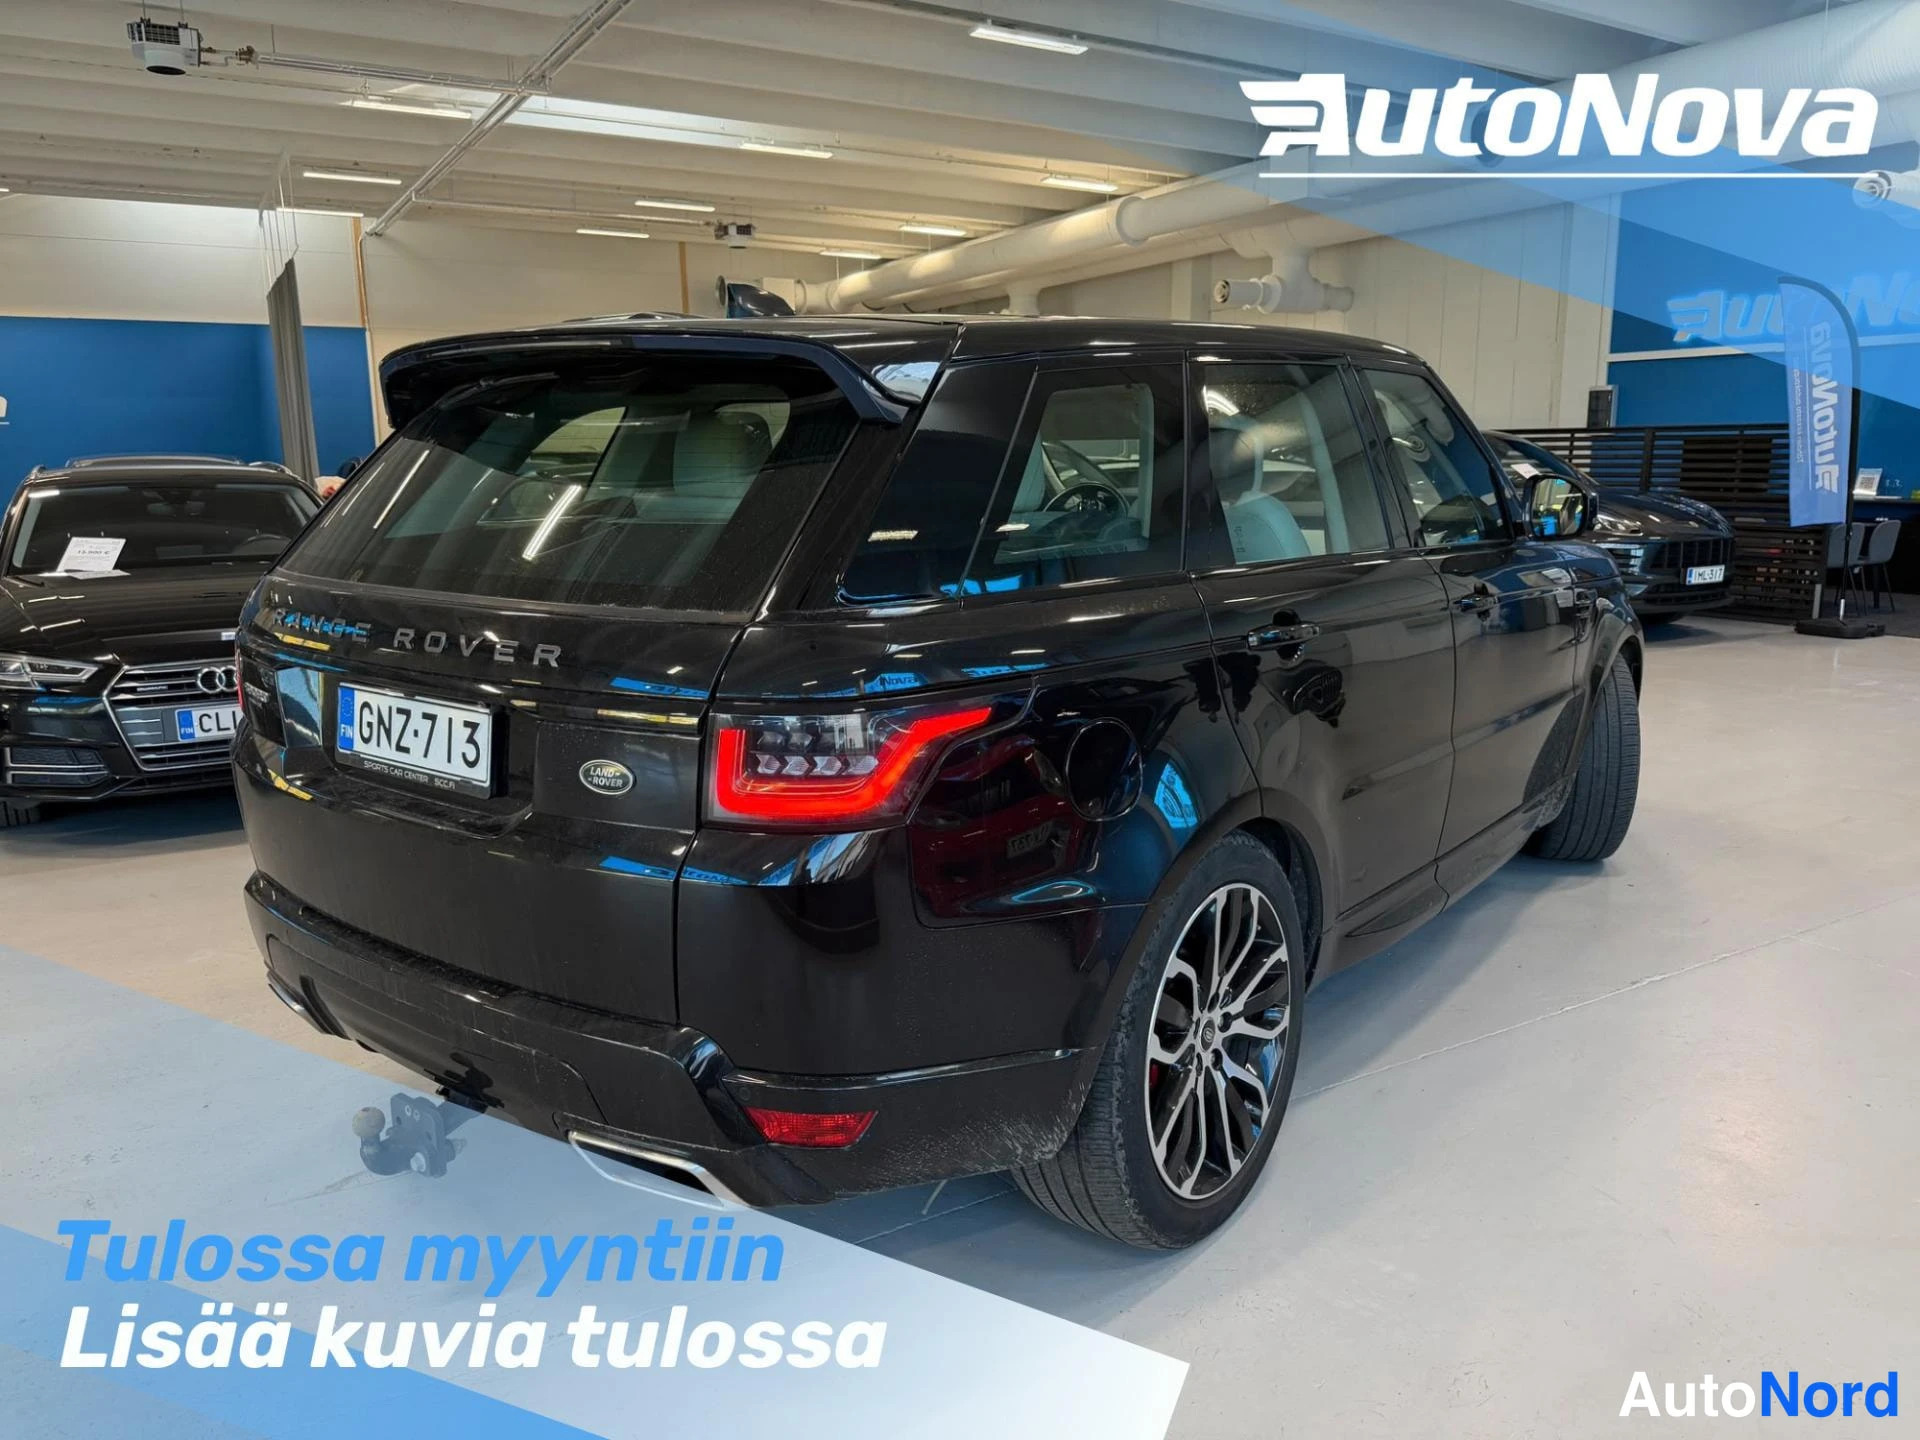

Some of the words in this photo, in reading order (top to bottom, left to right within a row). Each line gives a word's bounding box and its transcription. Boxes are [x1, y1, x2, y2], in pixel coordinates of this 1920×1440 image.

[272, 608, 371, 643] RANGE
[393, 627, 561, 668] ROVER
[340, 724, 353, 739] FIN
[359, 700, 481, 769] GNZ-713
[363, 761, 389, 774] SPORTS
[389, 767, 403, 778] CAR
[403, 770, 429, 784] CENTER
